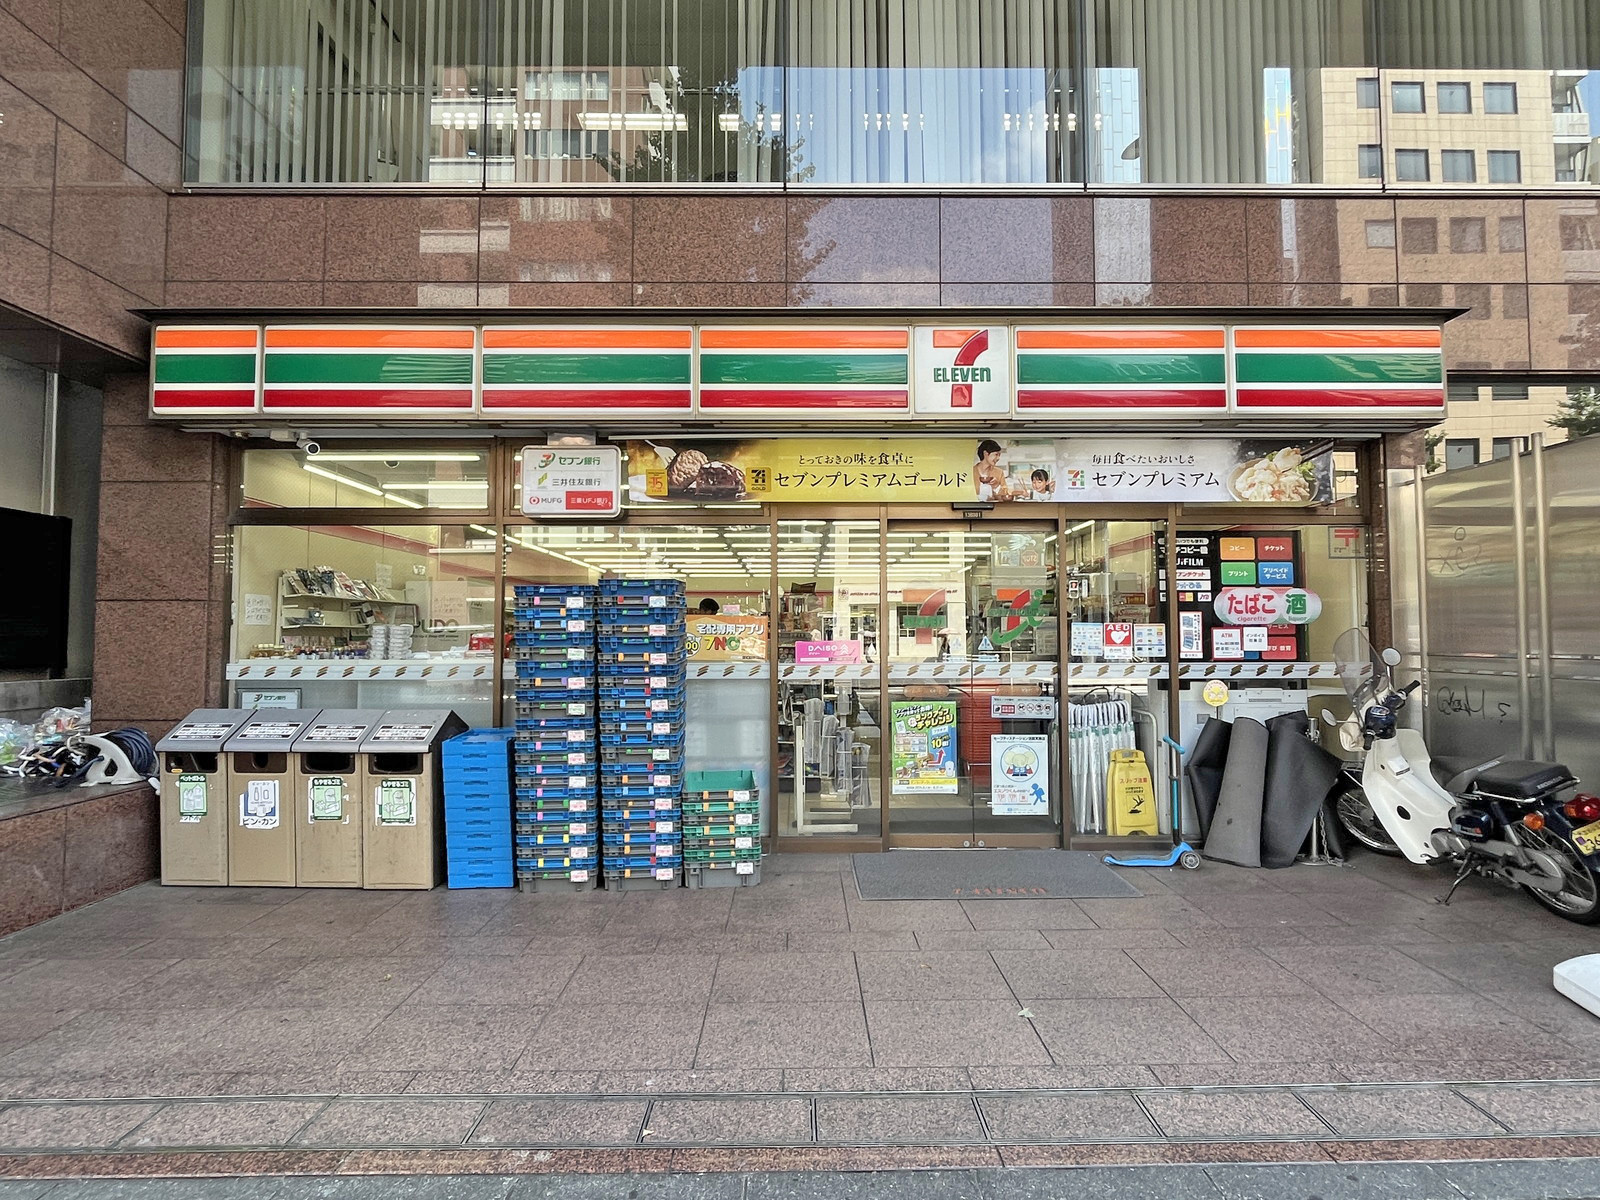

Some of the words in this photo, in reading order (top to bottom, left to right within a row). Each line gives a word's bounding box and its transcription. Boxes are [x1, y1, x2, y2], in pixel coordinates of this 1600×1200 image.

[558, 456, 601, 466] セブン銀行
[799, 453, 914, 465] とっておきの味を食卓に
[1092, 452, 1195, 465] 毎日食べたいおいしさ
[552, 478, 601, 487] 三井住友銀行
[774, 471, 968, 488] セブンプレミアムゴールド
[1092, 470, 1220, 488] セブンプレミアム
[1227, 593, 1277, 615] たばこ
[1285, 593, 1307, 615] 酒
[696, 623, 765, 636] 宅配専用アプリ
[917, 713, 954, 730] チャレンジ
